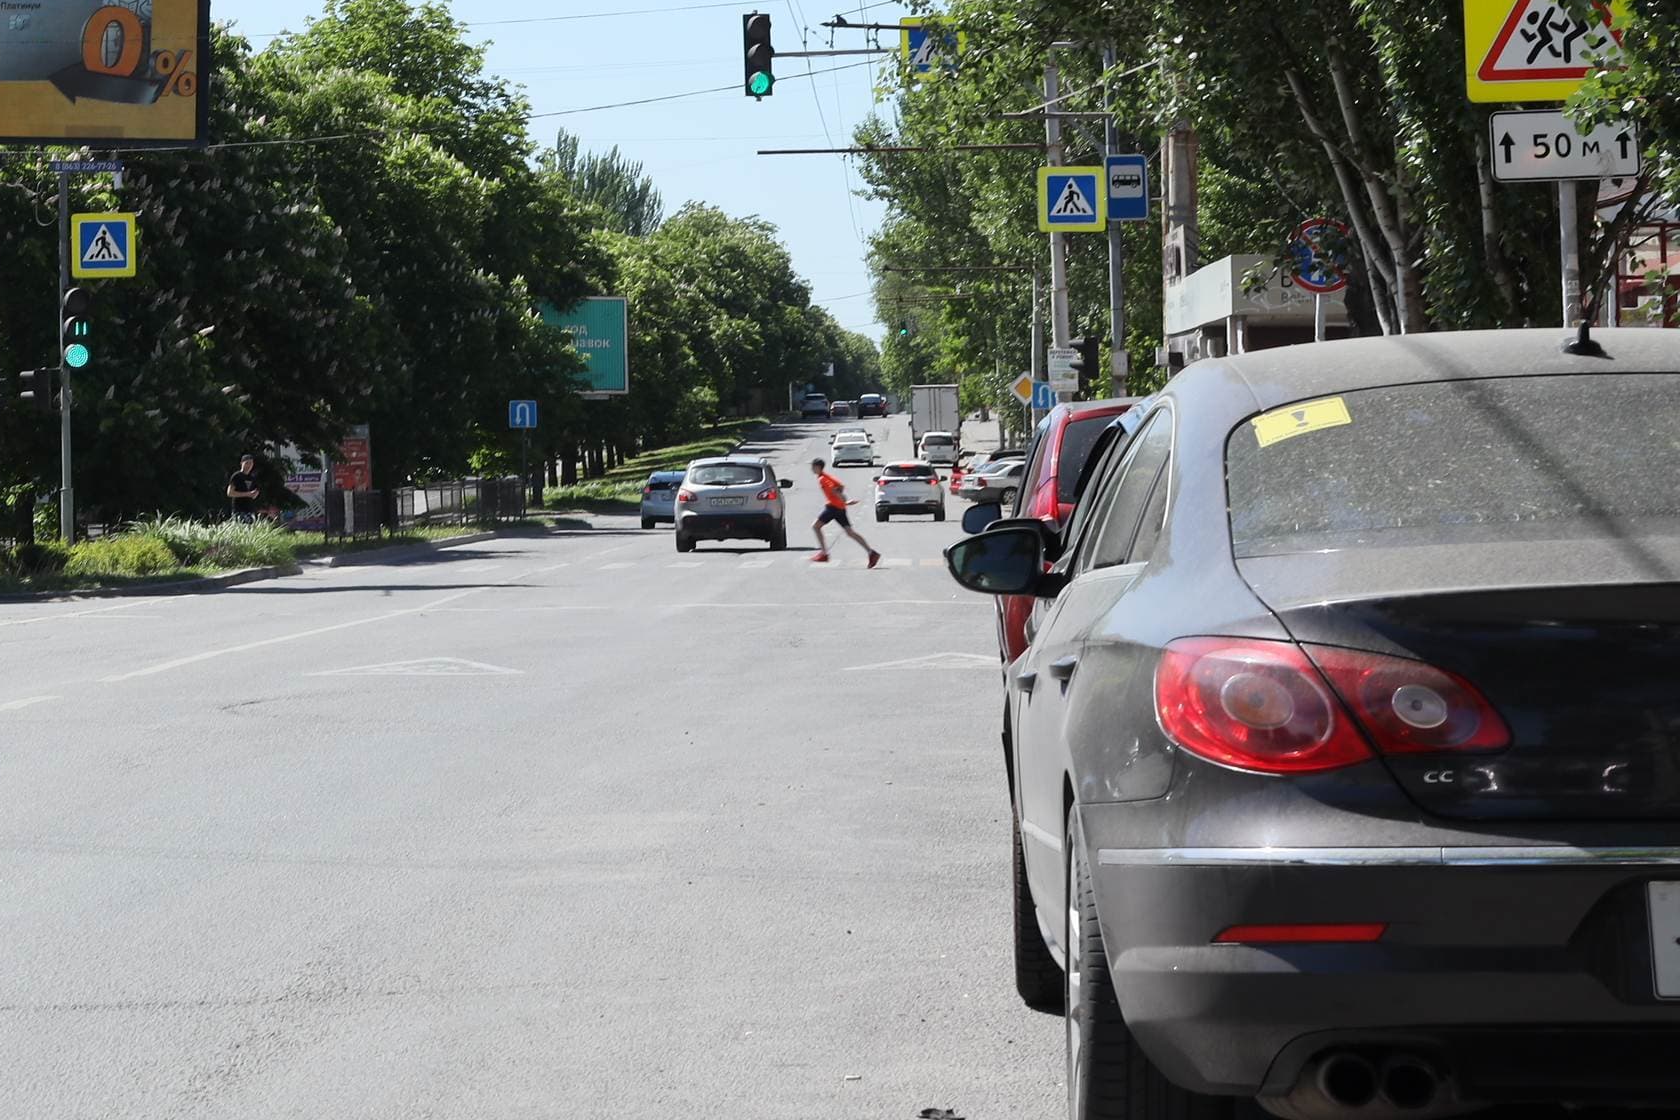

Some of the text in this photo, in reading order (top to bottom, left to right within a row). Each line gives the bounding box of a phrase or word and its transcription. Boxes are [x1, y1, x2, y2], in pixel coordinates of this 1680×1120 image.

[0, 2, 41, 11] Платинум
[1532, 133, 1600, 159] 50 м
[1423, 770, 1453, 783] CC
